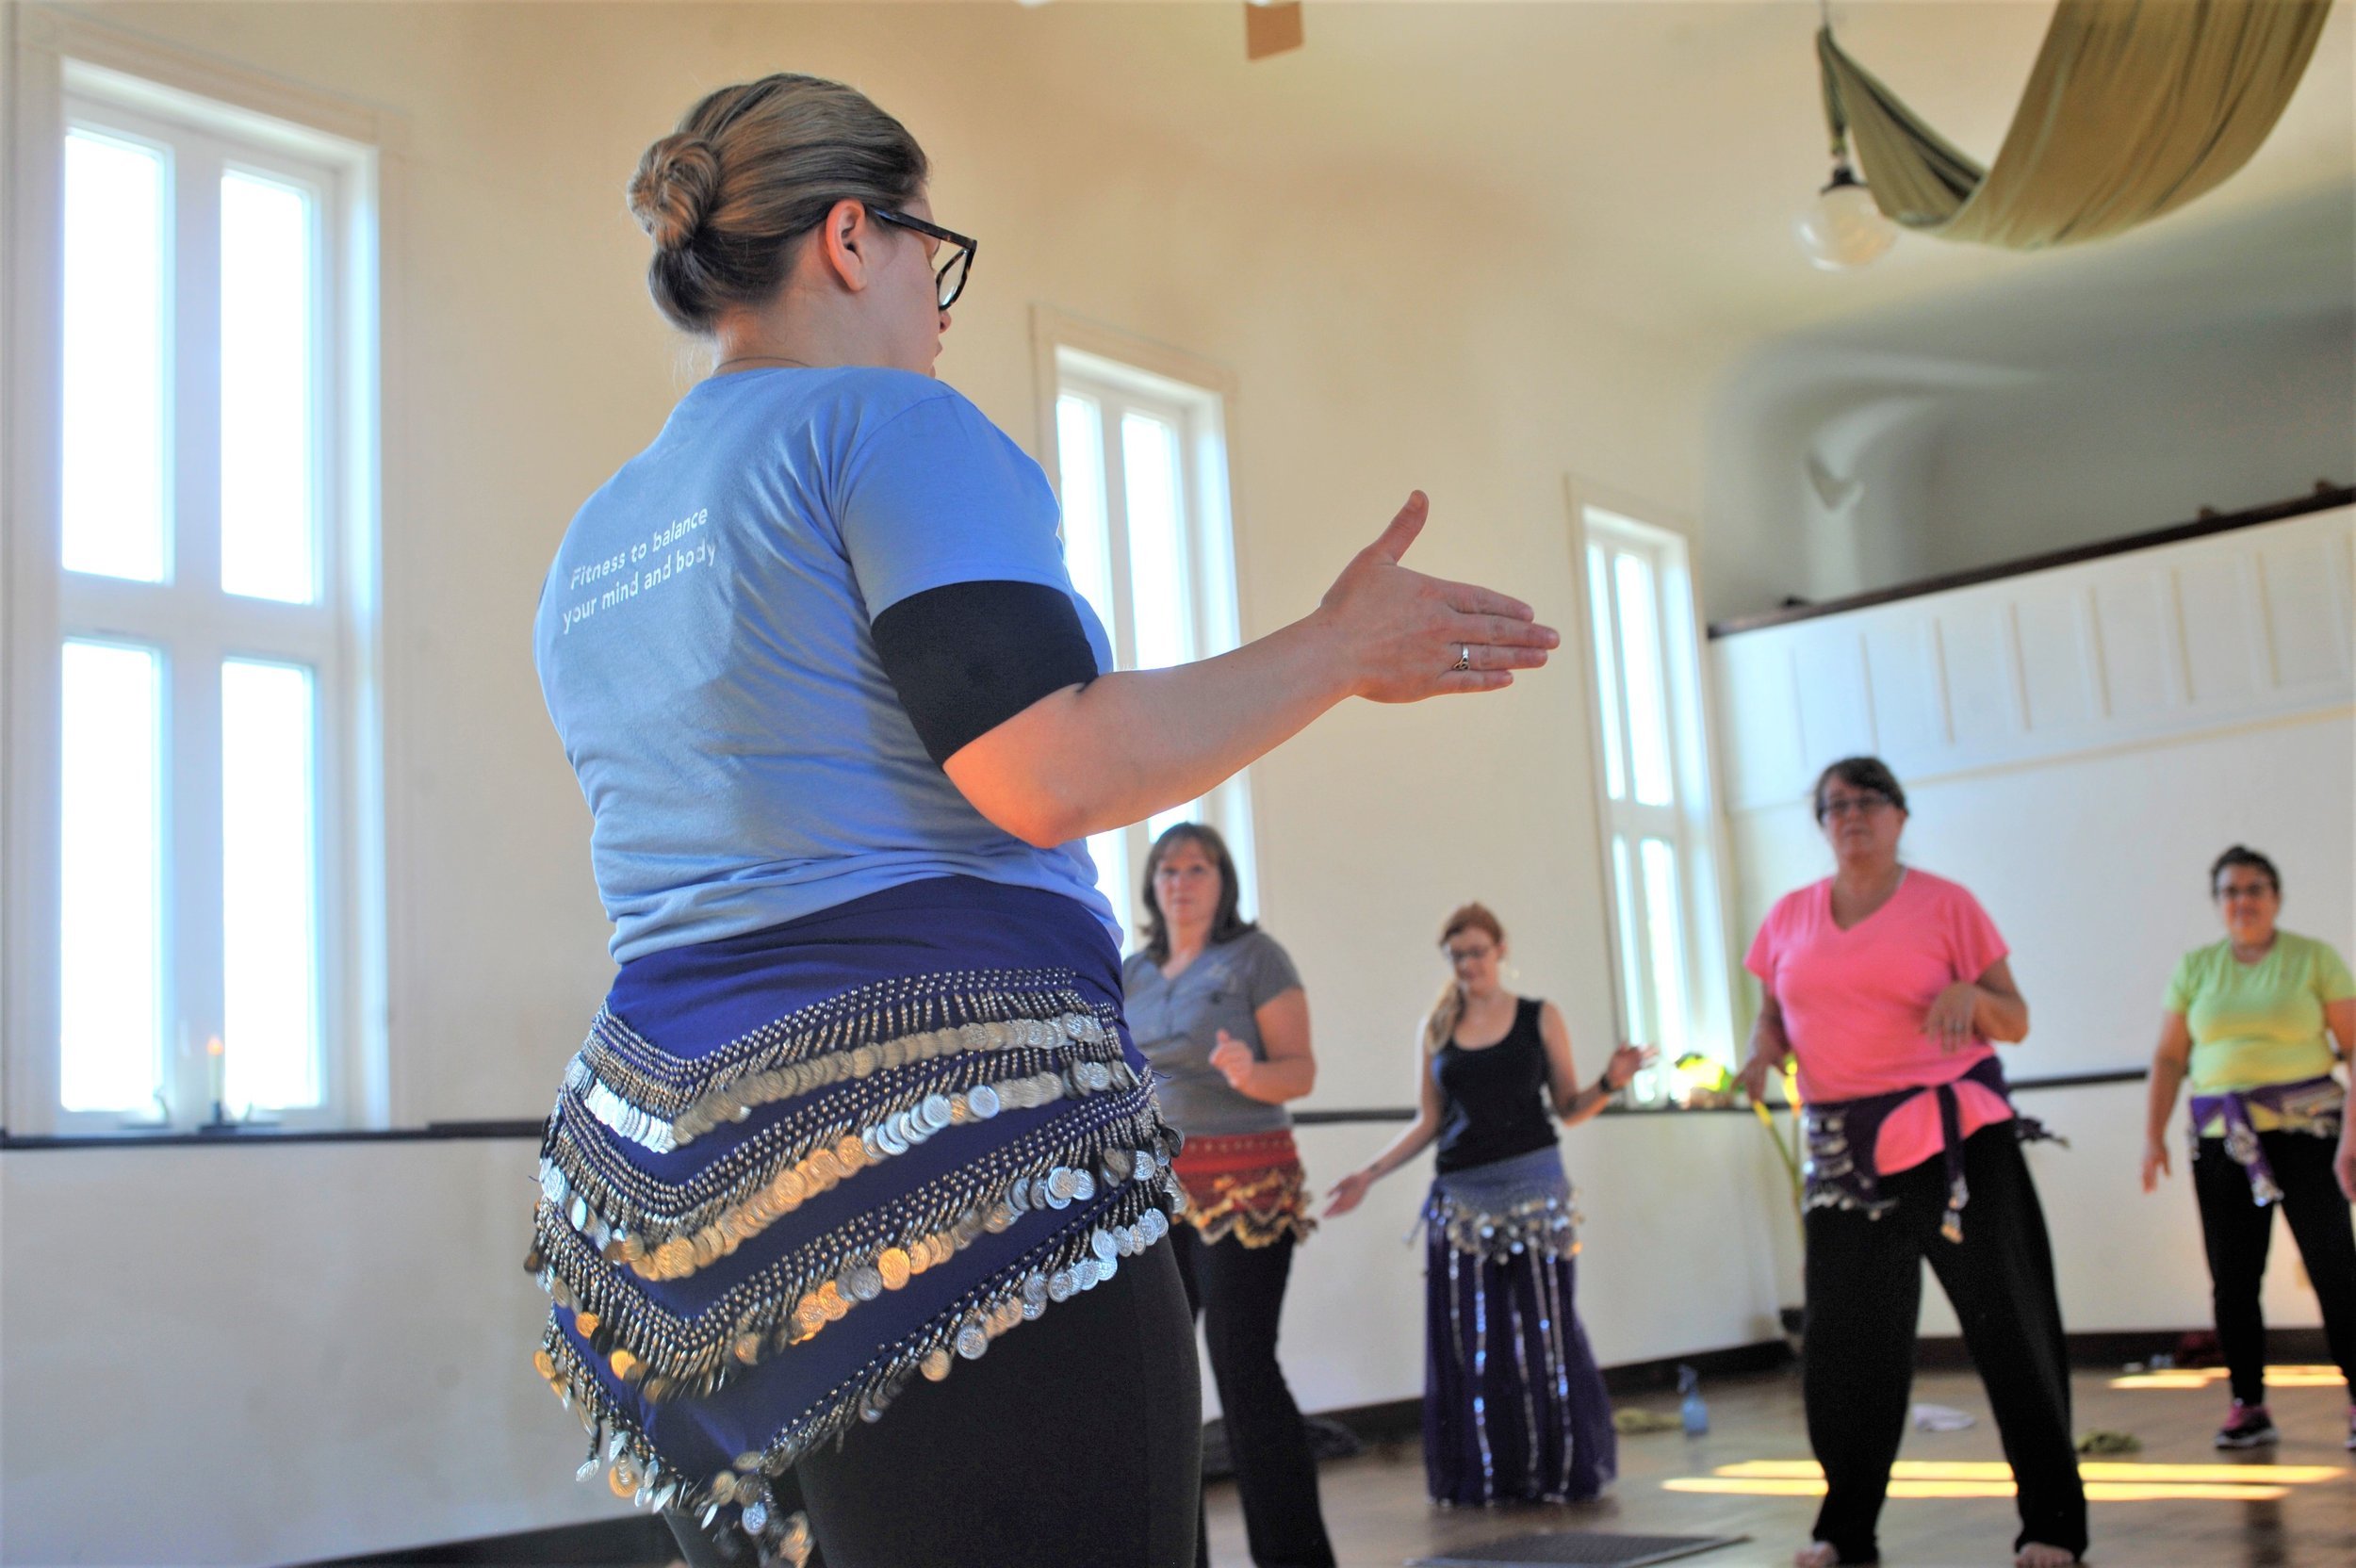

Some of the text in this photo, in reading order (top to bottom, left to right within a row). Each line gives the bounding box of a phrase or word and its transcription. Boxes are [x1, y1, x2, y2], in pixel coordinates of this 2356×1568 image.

[563, 538, 716, 634] your mind and body
[570, 508, 708, 590] Fitness to balance
